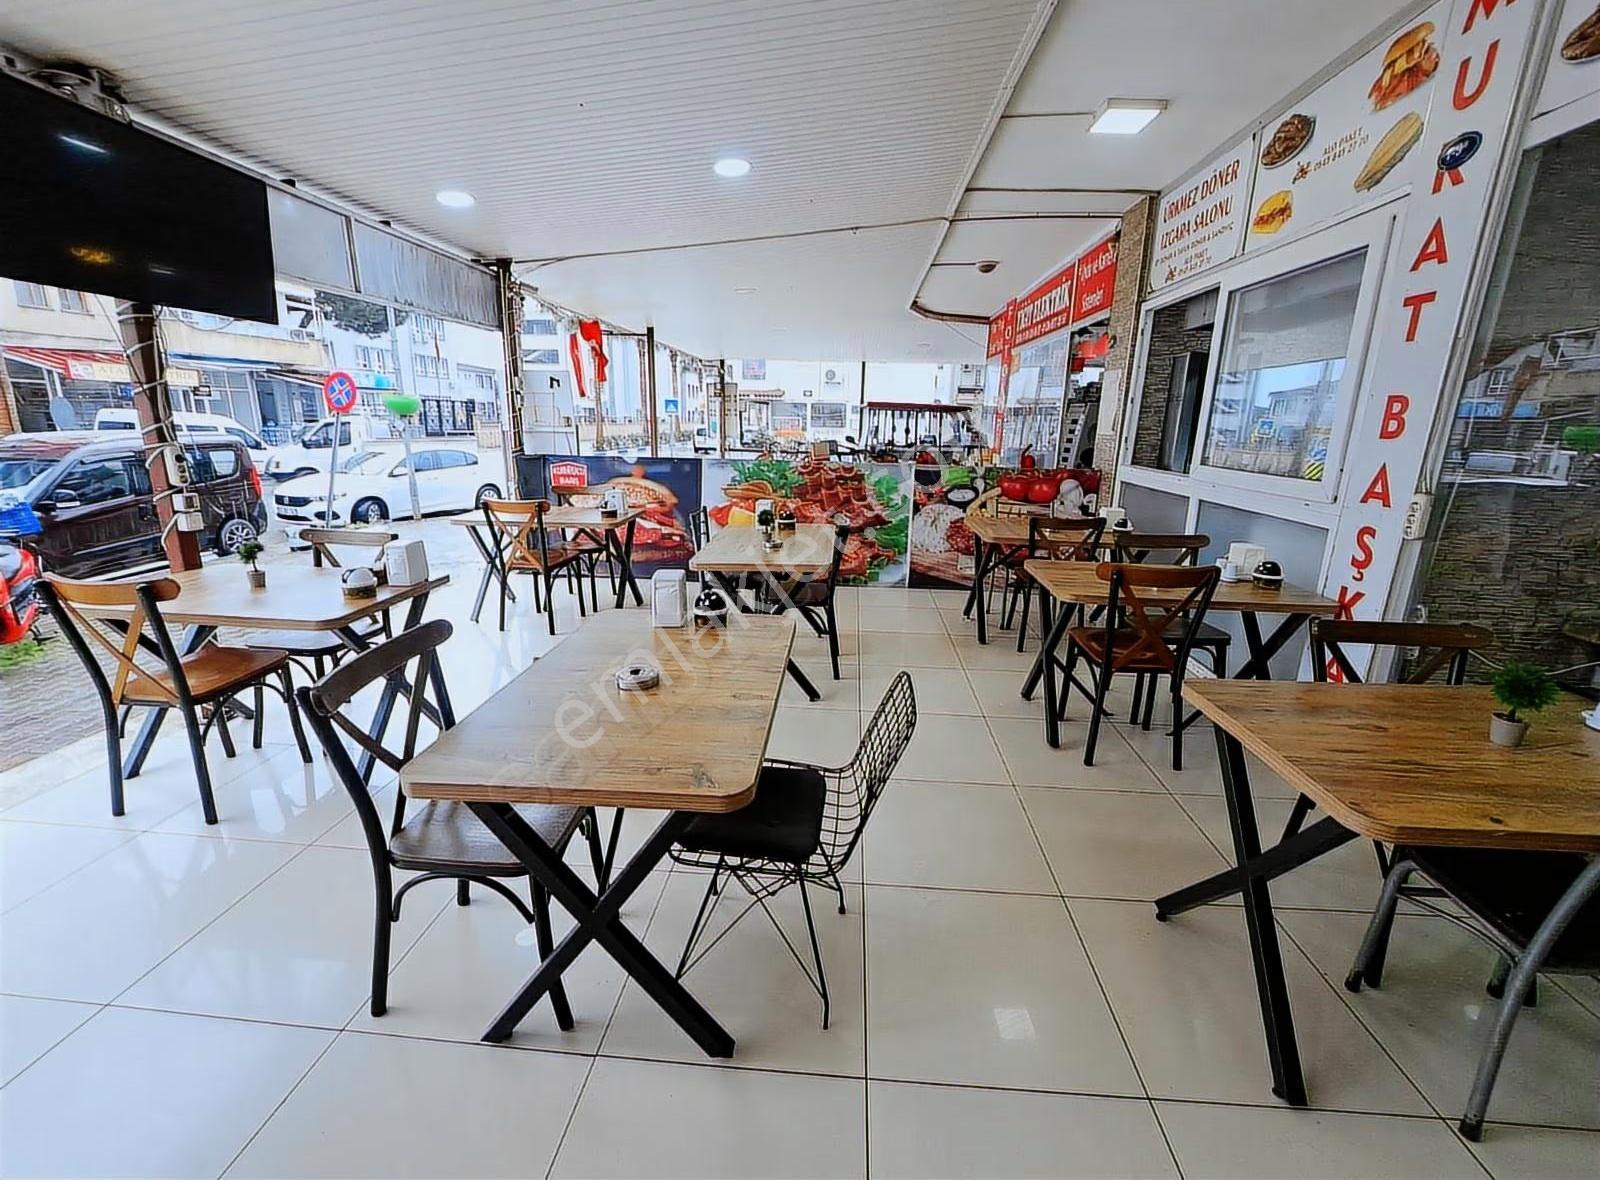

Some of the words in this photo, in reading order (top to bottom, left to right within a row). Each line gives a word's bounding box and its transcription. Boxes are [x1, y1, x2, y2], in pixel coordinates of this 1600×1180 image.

[1200, 158, 1240, 200] DÖNER
[1160, 219, 1191, 250] IZGARA
[1193, 194, 1234, 233] SALONU
